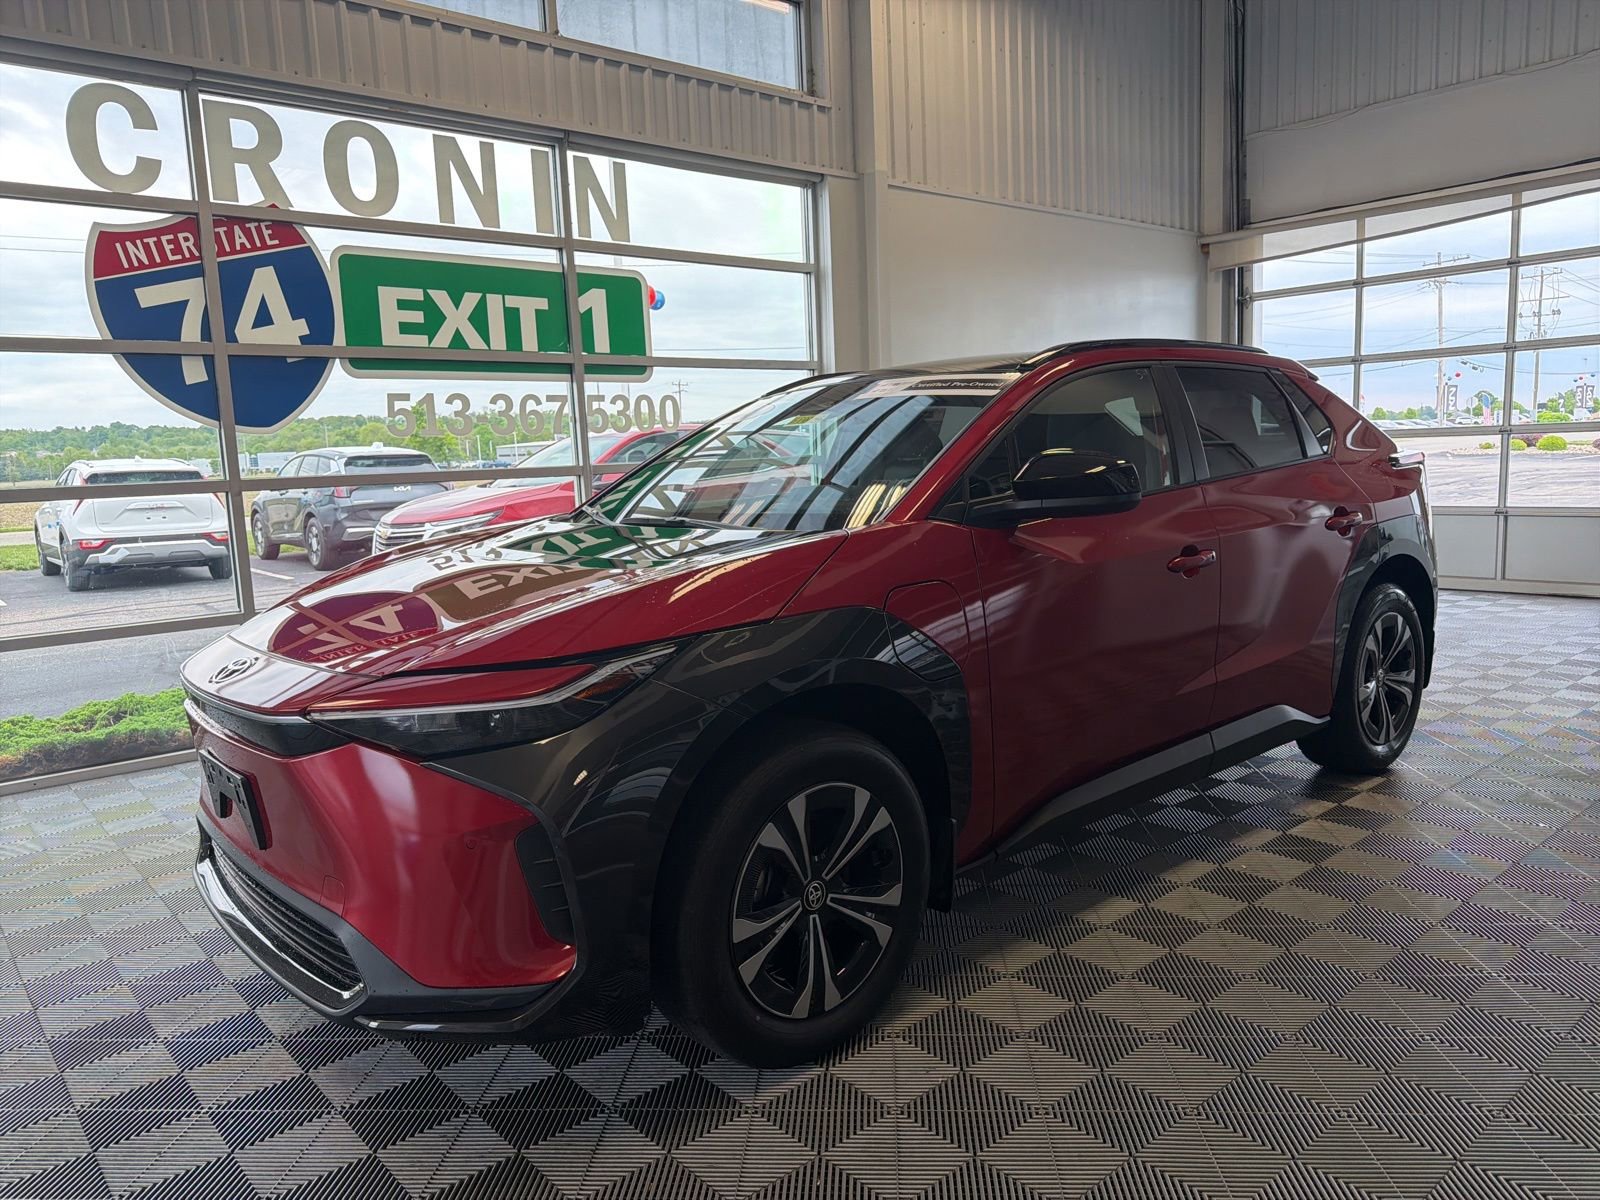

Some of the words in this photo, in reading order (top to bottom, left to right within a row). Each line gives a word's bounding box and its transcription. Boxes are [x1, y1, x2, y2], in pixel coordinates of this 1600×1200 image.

[65, 82, 632, 243] CRONIN
[115, 222, 280, 269] INTERTATE
[134, 265, 311, 386] 74
[377, 285, 549, 352] EXIT
[577, 288, 611, 354] 1
